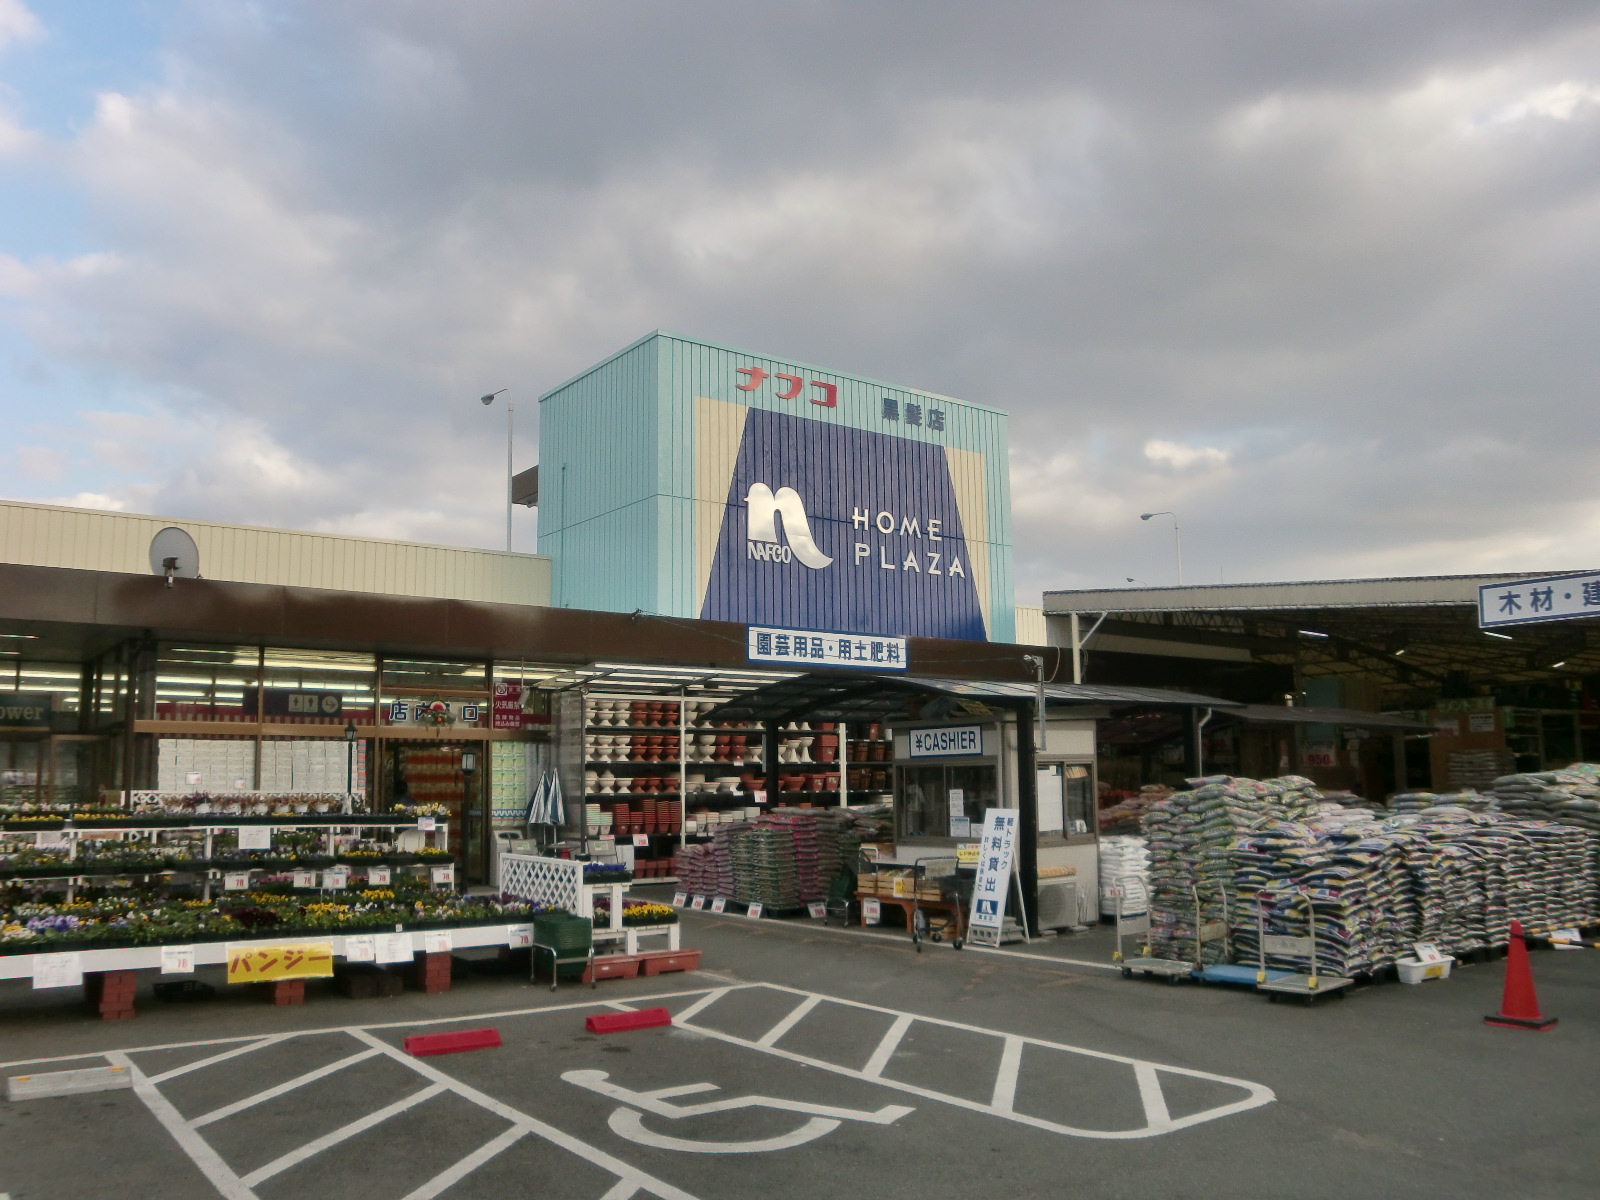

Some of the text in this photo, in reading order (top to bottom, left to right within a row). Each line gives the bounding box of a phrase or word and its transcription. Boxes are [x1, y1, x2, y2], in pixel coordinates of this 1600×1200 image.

[736, 366, 838, 408] ナフコ
[882, 397, 944, 432] 黒髪店
[851, 506, 943, 541] HOME
[748, 540, 792, 564] NAFCO
[854, 542, 965, 578] PLAZA
[756, 632, 900, 664] 園芸用品・用土肥料
[915, 730, 976, 752] ¥CASHIER
[985, 816, 1006, 893] 無料貸出
[230, 950, 330, 974] パンジー
